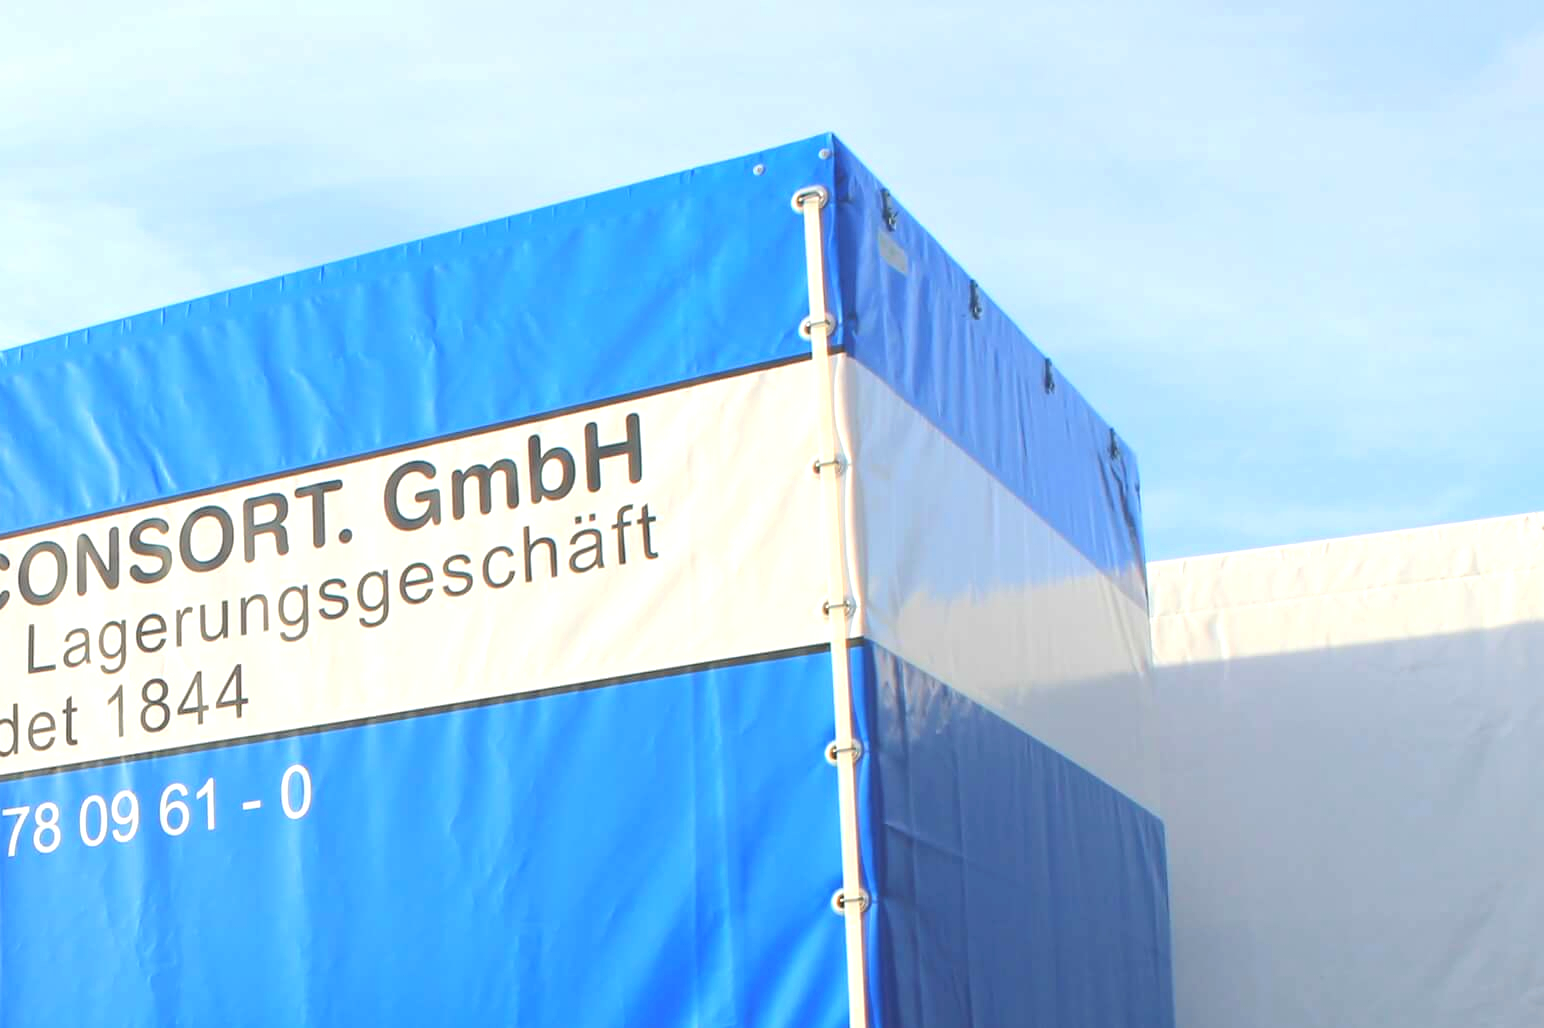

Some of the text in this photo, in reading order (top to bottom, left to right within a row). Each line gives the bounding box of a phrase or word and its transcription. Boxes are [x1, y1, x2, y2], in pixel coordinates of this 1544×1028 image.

[384, 412, 643, 531] GmbH
[26, 503, 659, 675] Lagerungsgeschäft
[106, 663, 249, 738] 1844
[2, 801, 62, 858] 78
[79, 789, 141, 848] 09
[159, 777, 217, 839] 61
[242, 799, 262, 812] -
[280, 763, 313, 821] 0
